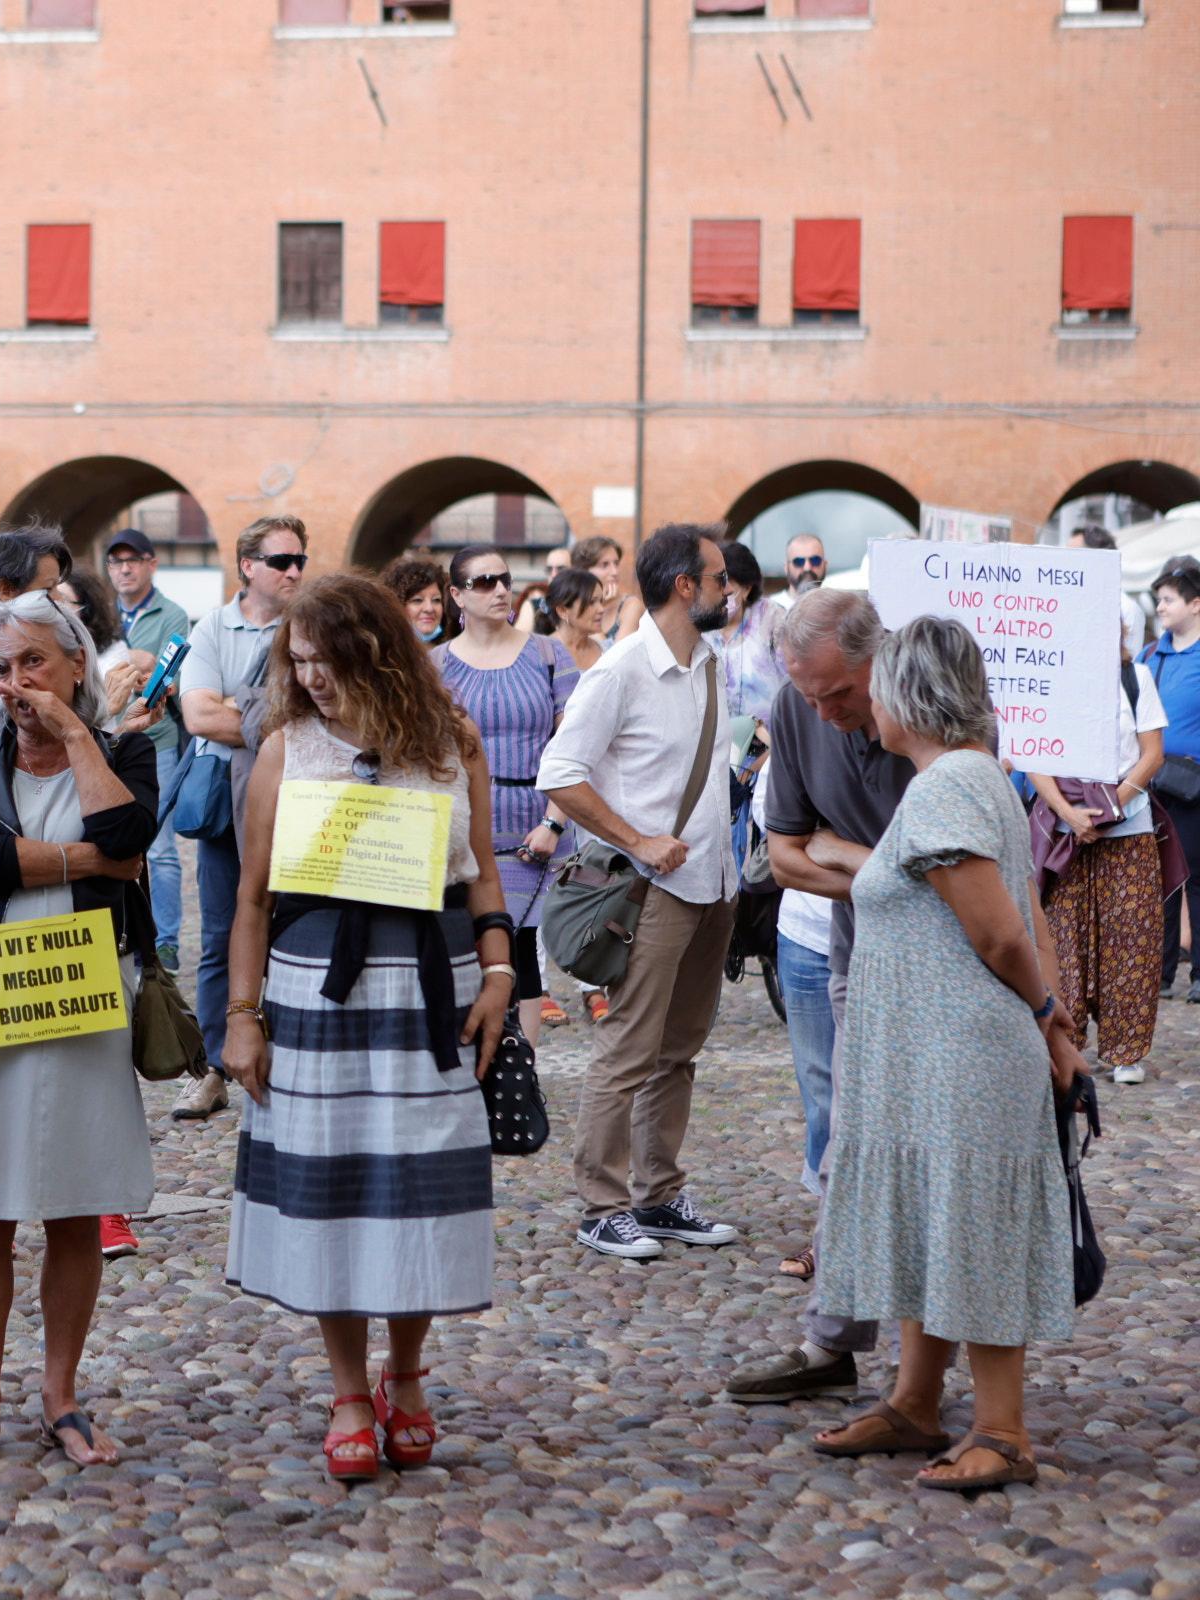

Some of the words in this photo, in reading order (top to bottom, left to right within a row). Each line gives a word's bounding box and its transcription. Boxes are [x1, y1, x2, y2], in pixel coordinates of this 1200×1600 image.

[963, 562, 1021, 583] HANNO
[1038, 567, 1084, 587] MESSI
[949, 590, 983, 608] UNO
[994, 594, 1058, 613] CONTRO
[976, 616, 1053, 639] L'ALTRO
[983, 647, 1005, 664] ON
[1015, 647, 1064, 666] FARCI
[987, 677, 1051, 696] ETTERE
[994, 706, 1047, 724] NTRO
[344, 821, 359, 830] Of
[345, 807, 402, 824] Certificate
[320, 831, 330, 841] V
[342, 833, 404, 851] Vaccination
[319, 844, 333, 854] ID
[346, 847, 382, 863] Digital
[384, 851, 426, 868] Identity
[5, 937, 23, 956] VI
[42, 927, 93, 951] NULLA
[3, 966, 63, 991] MEGLIO
[67, 963, 85, 981] DI
[0, 1001, 56, 1025] BUONA
[58, 992, 119, 1017] SALUTE
